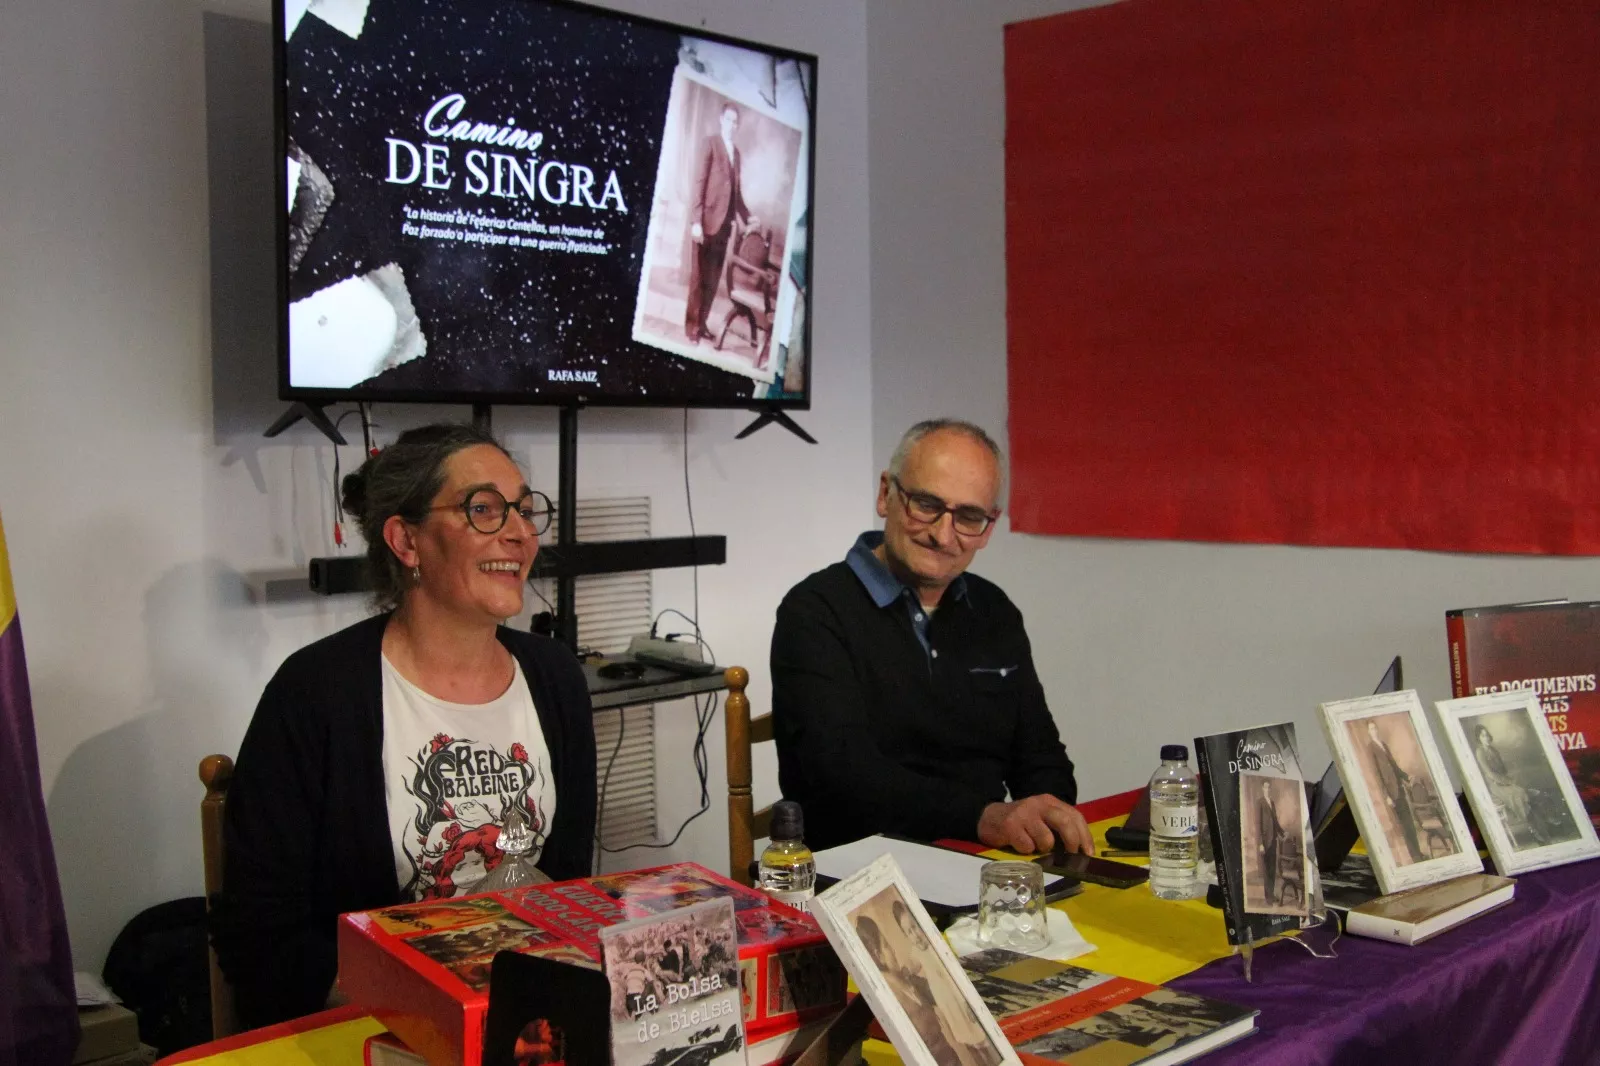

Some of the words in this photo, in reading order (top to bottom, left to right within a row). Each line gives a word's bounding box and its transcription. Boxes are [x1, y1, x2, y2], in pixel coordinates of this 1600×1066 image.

[424, 93, 544, 151] Camino
[385, 137, 452, 190] DE
[465, 150, 628, 213] SINGRA
[402, 223, 419, 236] Paz
[419, 224, 456, 239] forzado
[464, 230, 508, 245] participar
[521, 237, 538, 248] una
[538, 239, 566, 251] guerra
[420, 207, 455, 224] historia
[456, 210, 468, 225] de
[468, 213, 506, 229] Federico
[549, 224, 560, 235] un
[561, 224, 593, 238] hombre
[593, 228, 605, 240] de
[548, 369, 573, 381] RAFA
[574, 370, 597, 382] SAIZ
[1500, 674, 1597, 696] DOCUMENTS
[455, 745, 506, 777] RED
[1228, 759, 1243, 774] DE
[1245, 753, 1286, 771] SINGRA
[443, 772, 519, 798] BALEINE
[633, 993, 659, 1016] La
[666, 973, 722, 1005] Bolsa
[637, 1020, 661, 1043] de
[669, 998, 734, 1034] Bielsa
